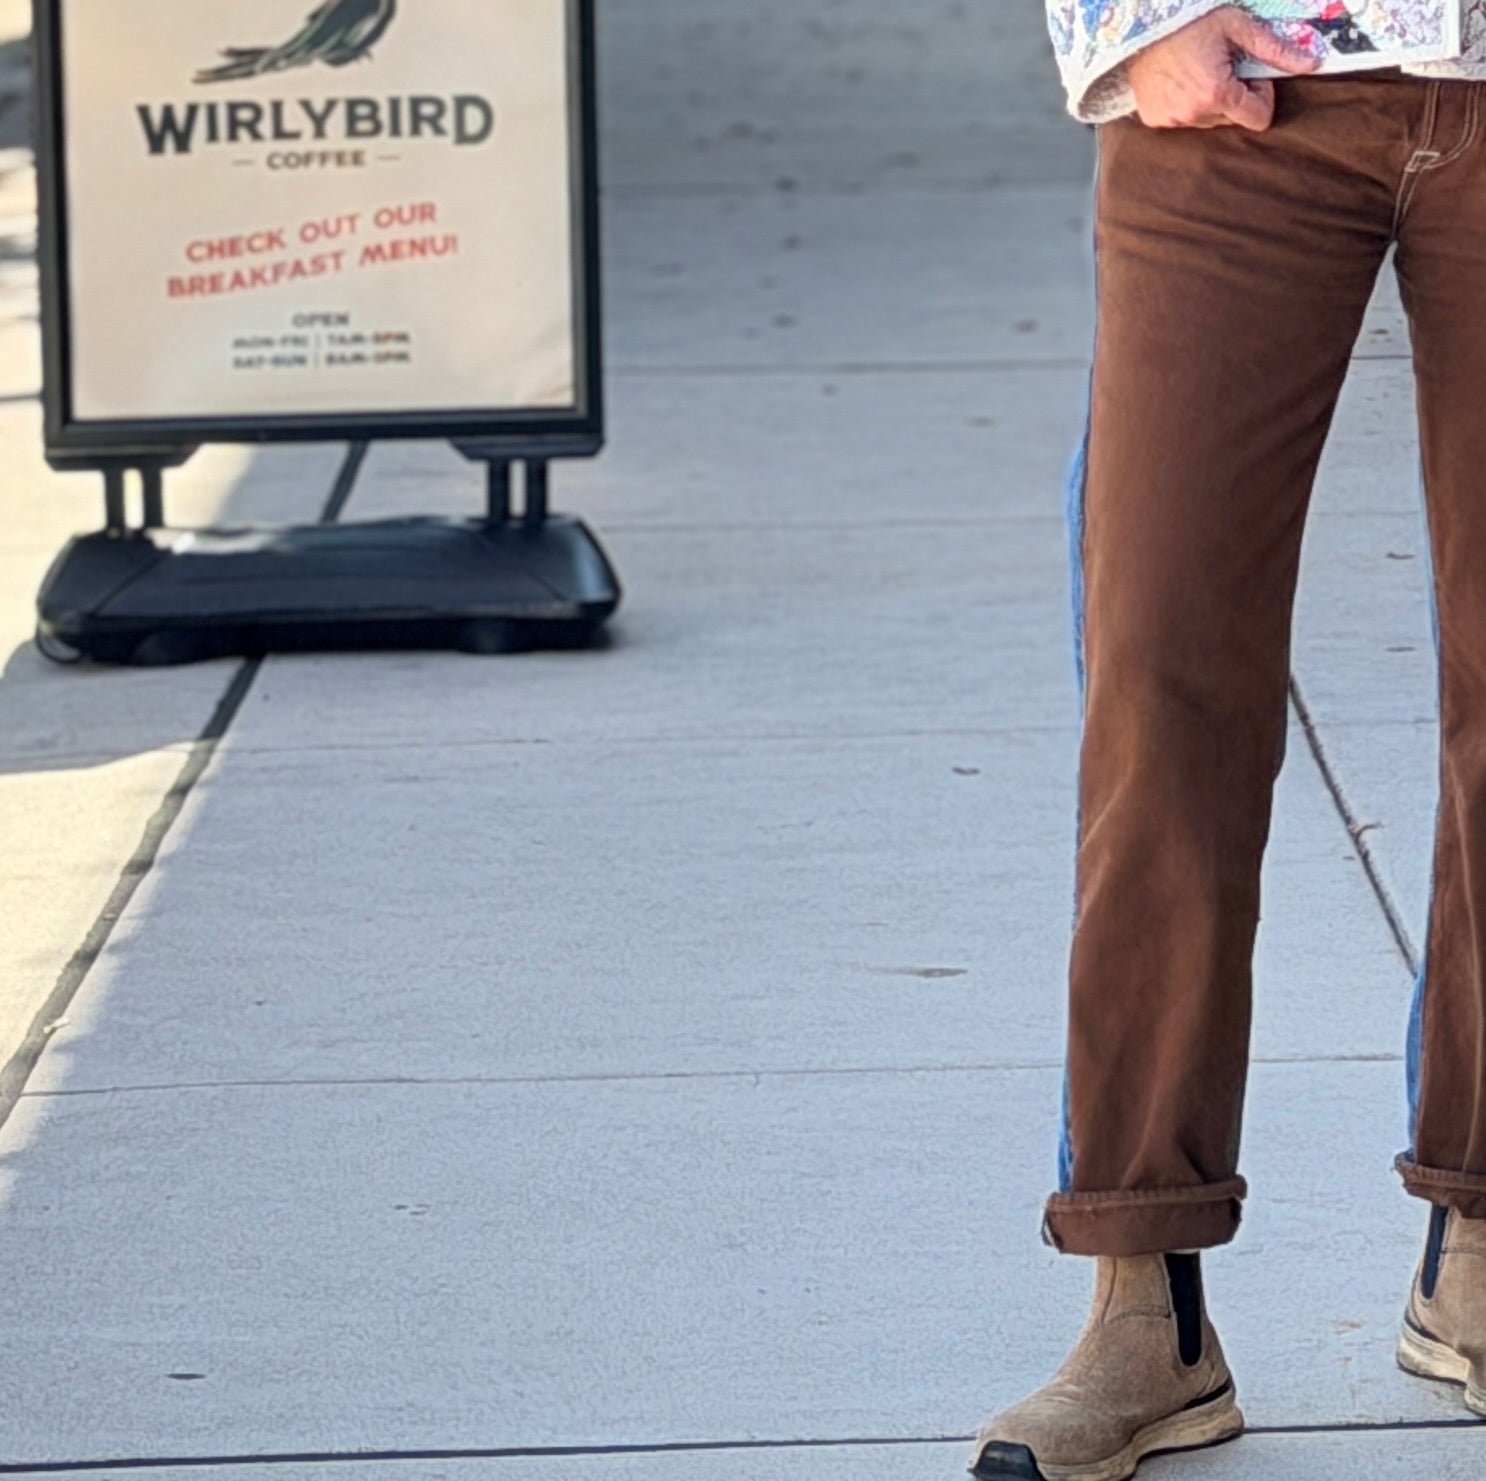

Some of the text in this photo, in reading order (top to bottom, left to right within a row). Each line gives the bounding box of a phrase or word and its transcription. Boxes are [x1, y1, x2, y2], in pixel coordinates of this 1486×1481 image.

[136, 94, 494, 156] WIRLYBIRD
[266, 150, 365, 170] COFFEE
[185, 202, 436, 263] CHECK OUT OUR
[166, 234, 458, 297] BREAKFAST MENU!
[292, 313, 349, 327] OPEN
